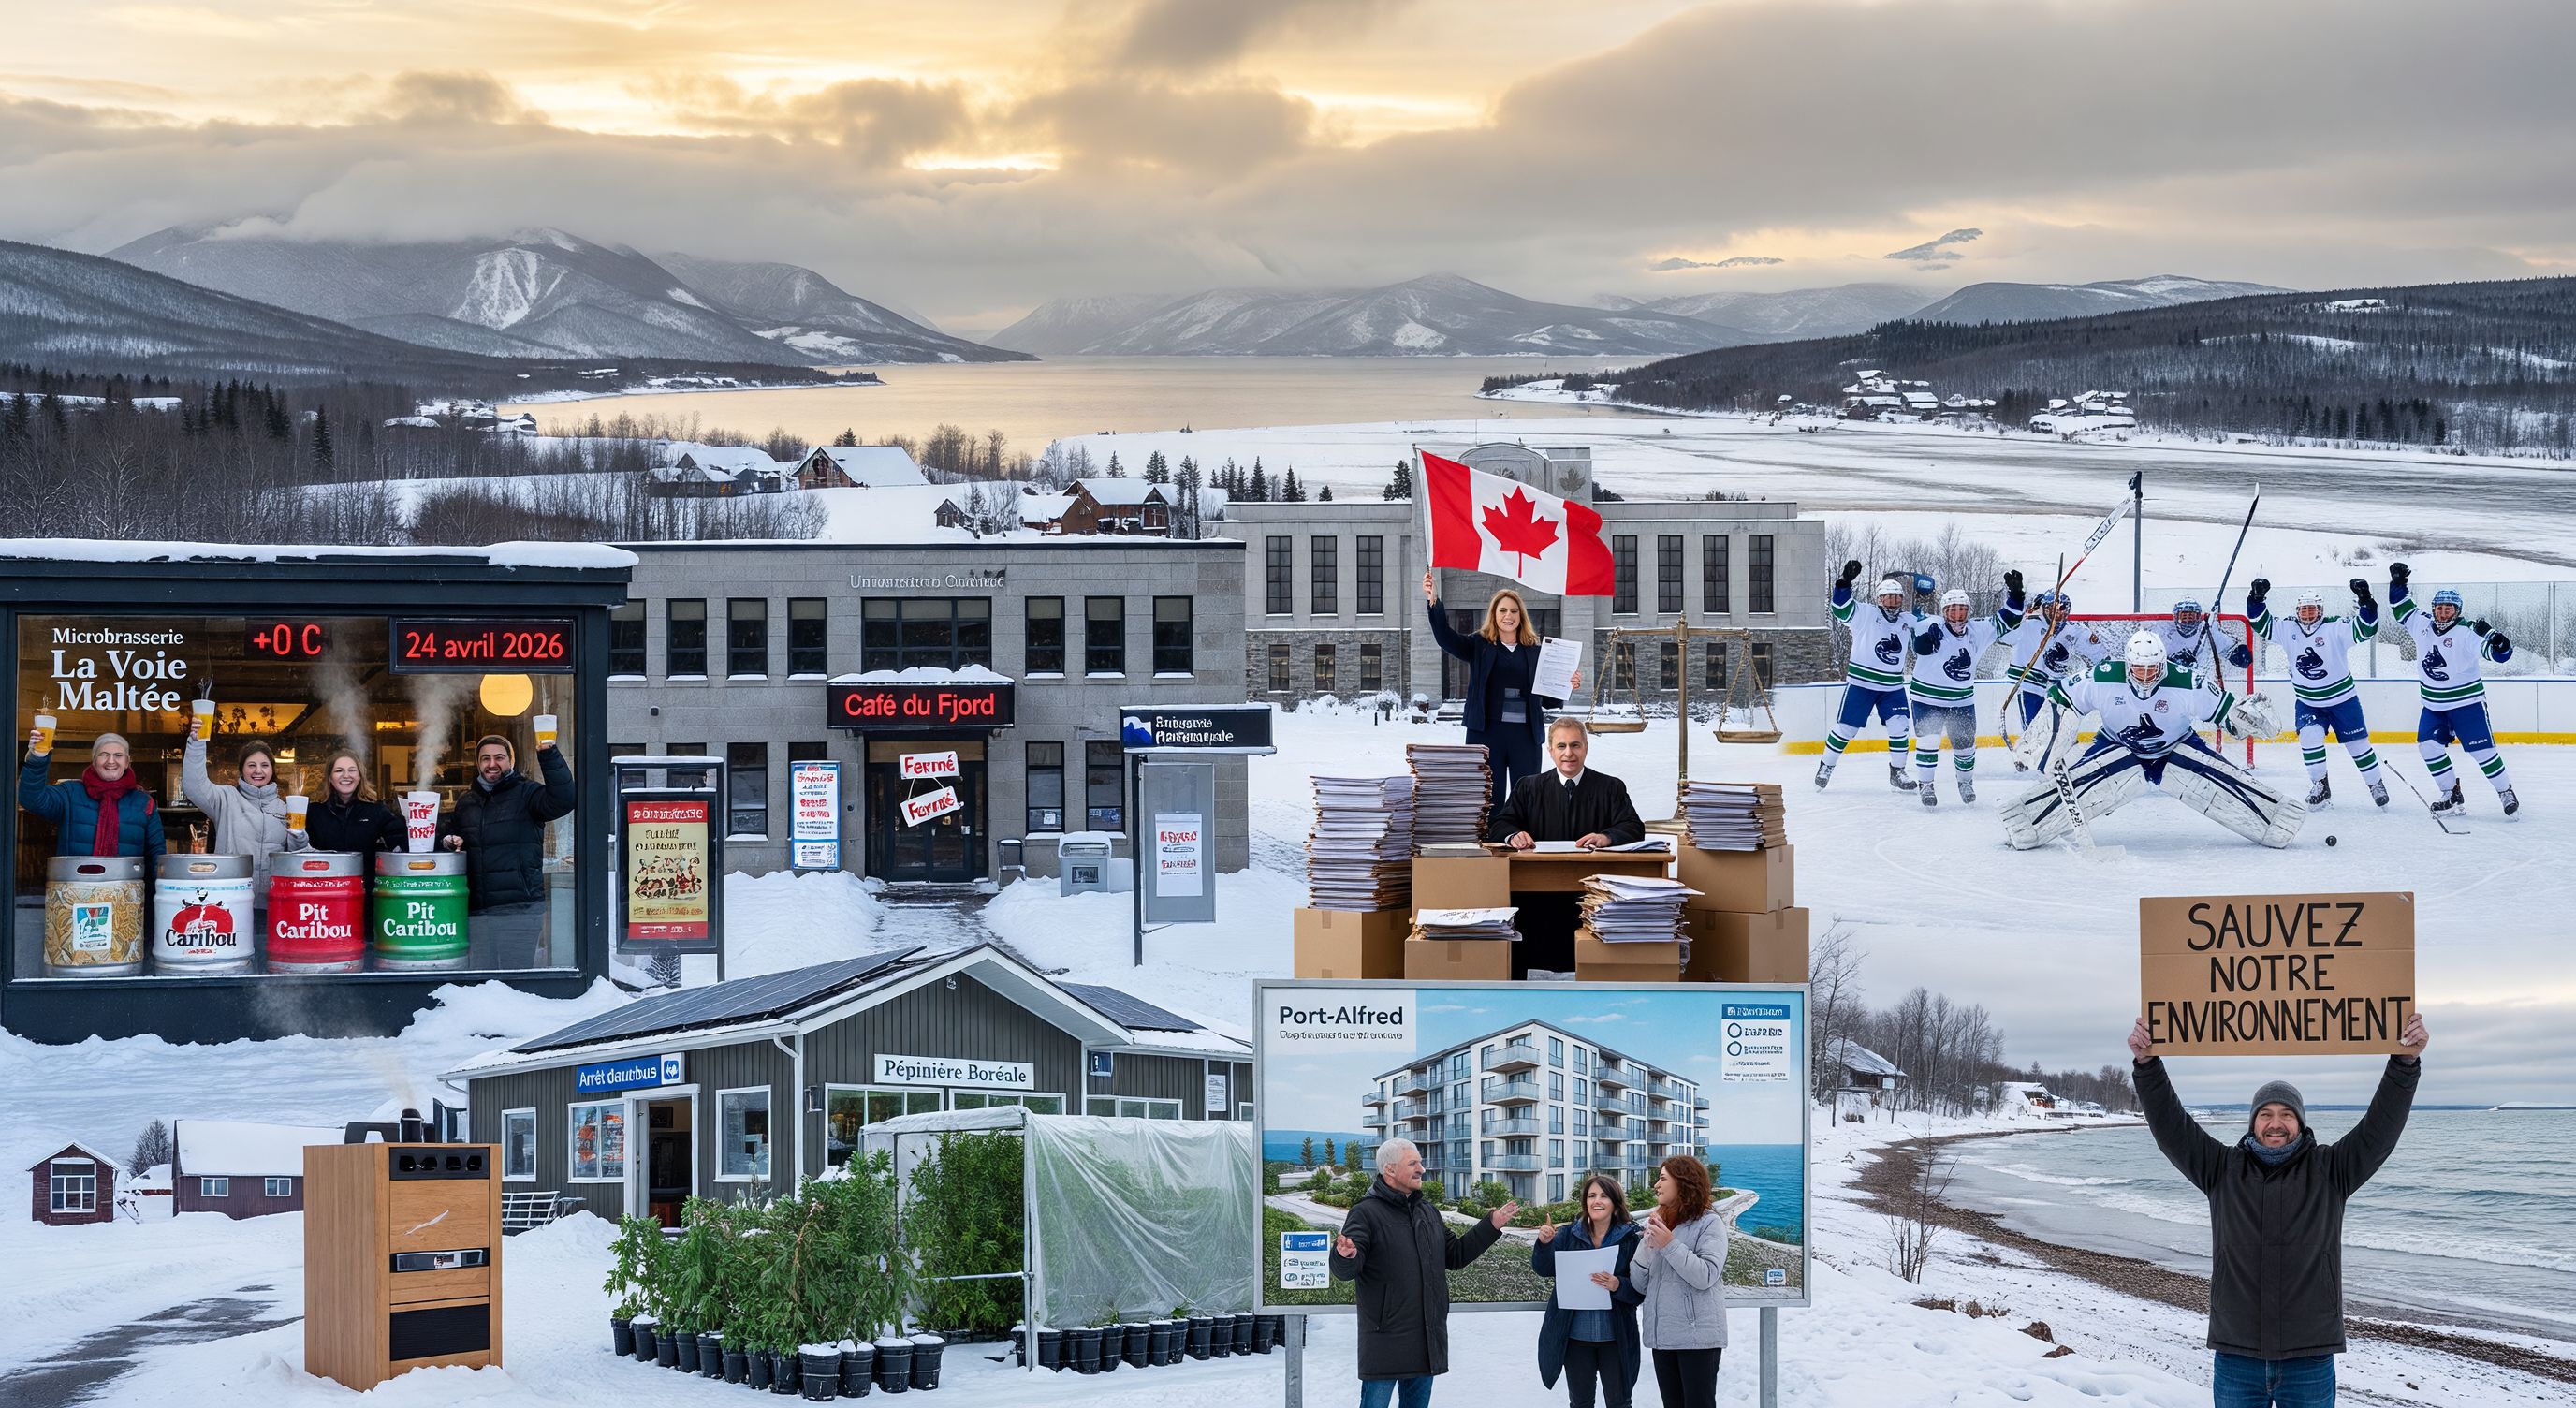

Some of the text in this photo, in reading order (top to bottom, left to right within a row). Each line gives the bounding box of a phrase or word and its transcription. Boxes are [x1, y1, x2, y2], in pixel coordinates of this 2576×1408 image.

[52, 627, 183, 644] Microbrasserie
[301, 623, 322, 655] C
[405, 632, 564, 659] 24 avril 2026
[51, 650, 187, 679] La Voie
[57, 682, 181, 711] Maltée
[844, 693, 995, 722] Café du Fjord
[904, 754, 955, 774] Fermé
[299, 903, 329, 921] Pit
[407, 902, 436, 919] Pit
[165, 928, 237, 947] Caribou
[276, 920, 352, 939] Caribou
[383, 918, 457, 937] Caribou
[2187, 902, 2365, 951] SAUVEZ
[2210, 953, 2335, 993] NOTRE
[1280, 1005, 1403, 1025] Port-Alfred
[2147, 996, 2411, 1045] ENVIRONNEMENT
[884, 1059, 1027, 1082] Pépinière Boréale
